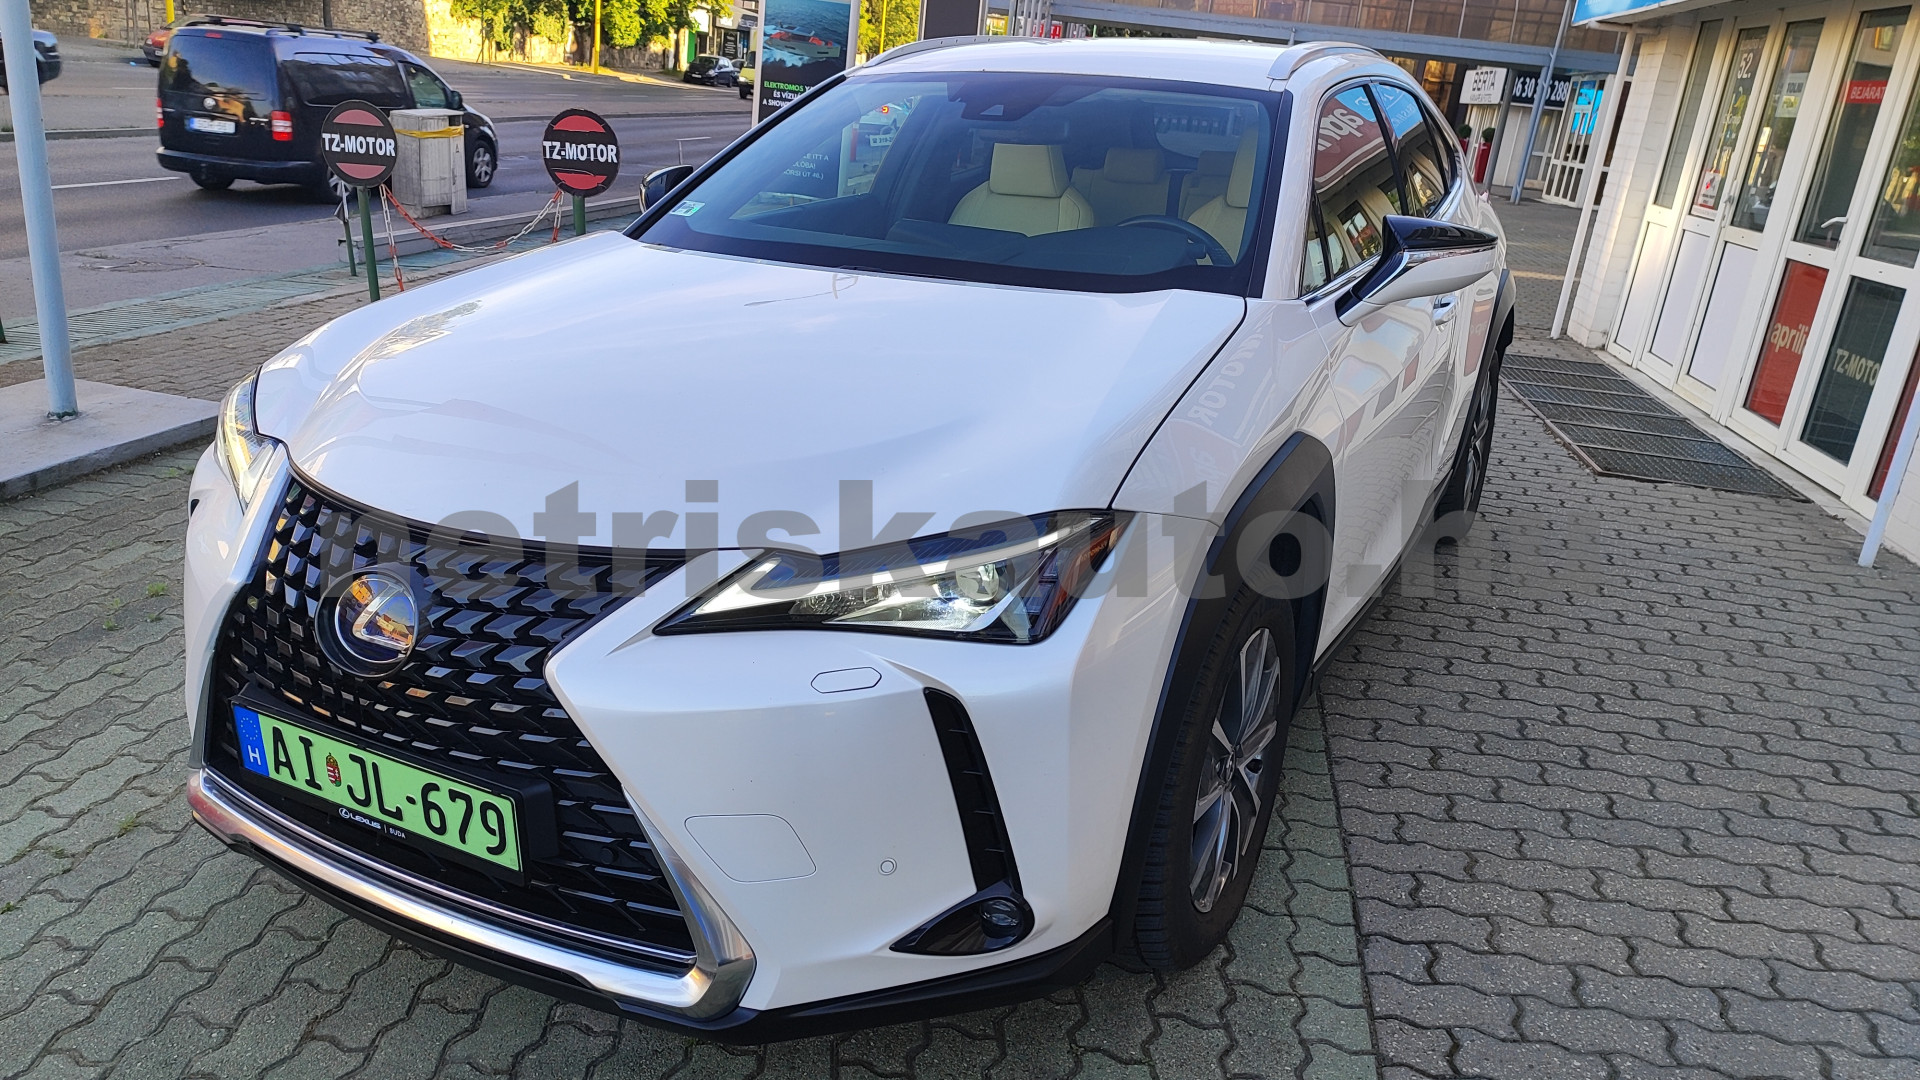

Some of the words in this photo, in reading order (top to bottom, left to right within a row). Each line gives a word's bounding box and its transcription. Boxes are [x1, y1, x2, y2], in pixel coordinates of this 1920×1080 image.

[763, 80, 804, 92] ELEKTROMOS
[1471, 70, 1496, 91] BERTA
[762, 98, 768, 106] A
[773, 89, 781, 98] ÉS
[322, 132, 396, 157] TZ-MOTOR
[542, 140, 618, 164] TZ-MOTOR
[247, 744, 262, 767] H
[272, 725, 323, 791] AI
[350, 812, 382, 830] LEXUS
[389, 827, 406, 839] BUDA
